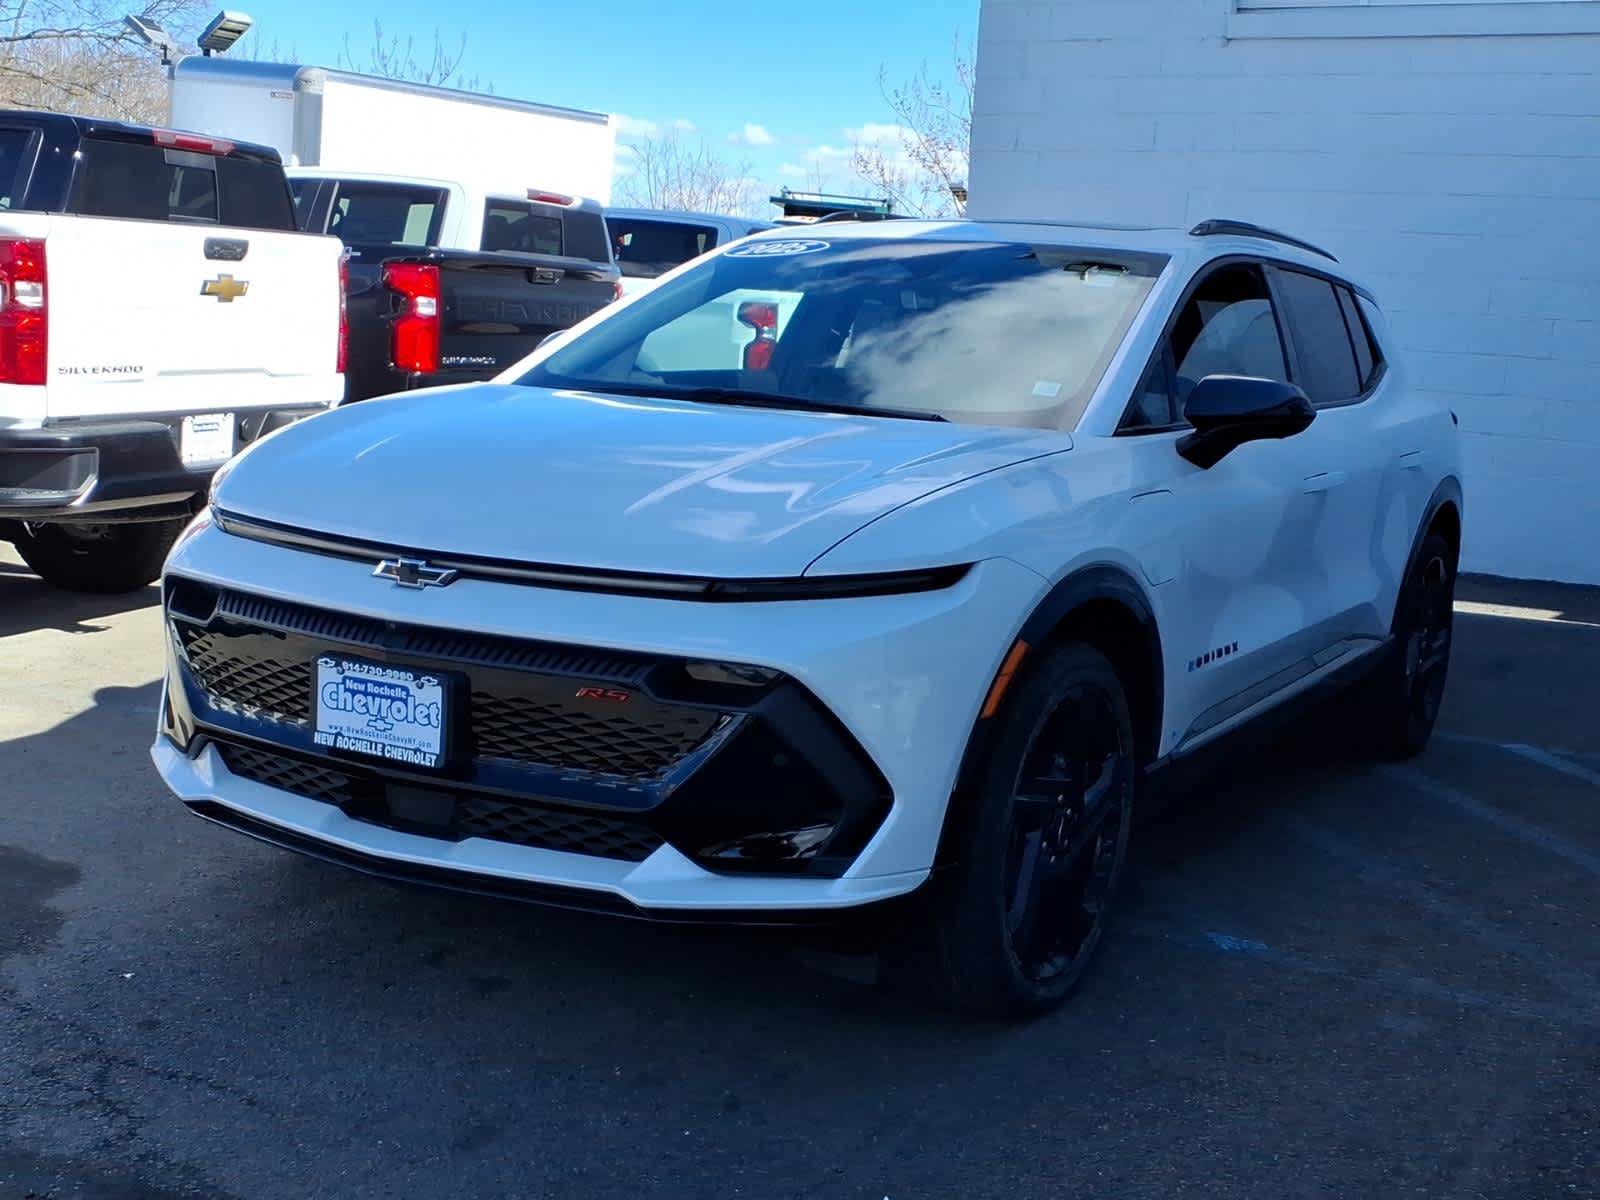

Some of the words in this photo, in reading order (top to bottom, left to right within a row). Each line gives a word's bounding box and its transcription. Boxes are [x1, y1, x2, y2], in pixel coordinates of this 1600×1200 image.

[58, 365, 143, 375] SILVERADO
[345, 679, 366, 690] New
[367, 683, 407, 698] Rochelle
[576, 687, 630, 701] RS
[322, 681, 440, 728] Chevrolet
[314, 731, 335, 747] NEW
[337, 735, 383, 757] ROCHELLE
[384, 746, 437, 768] CHEVROLET
